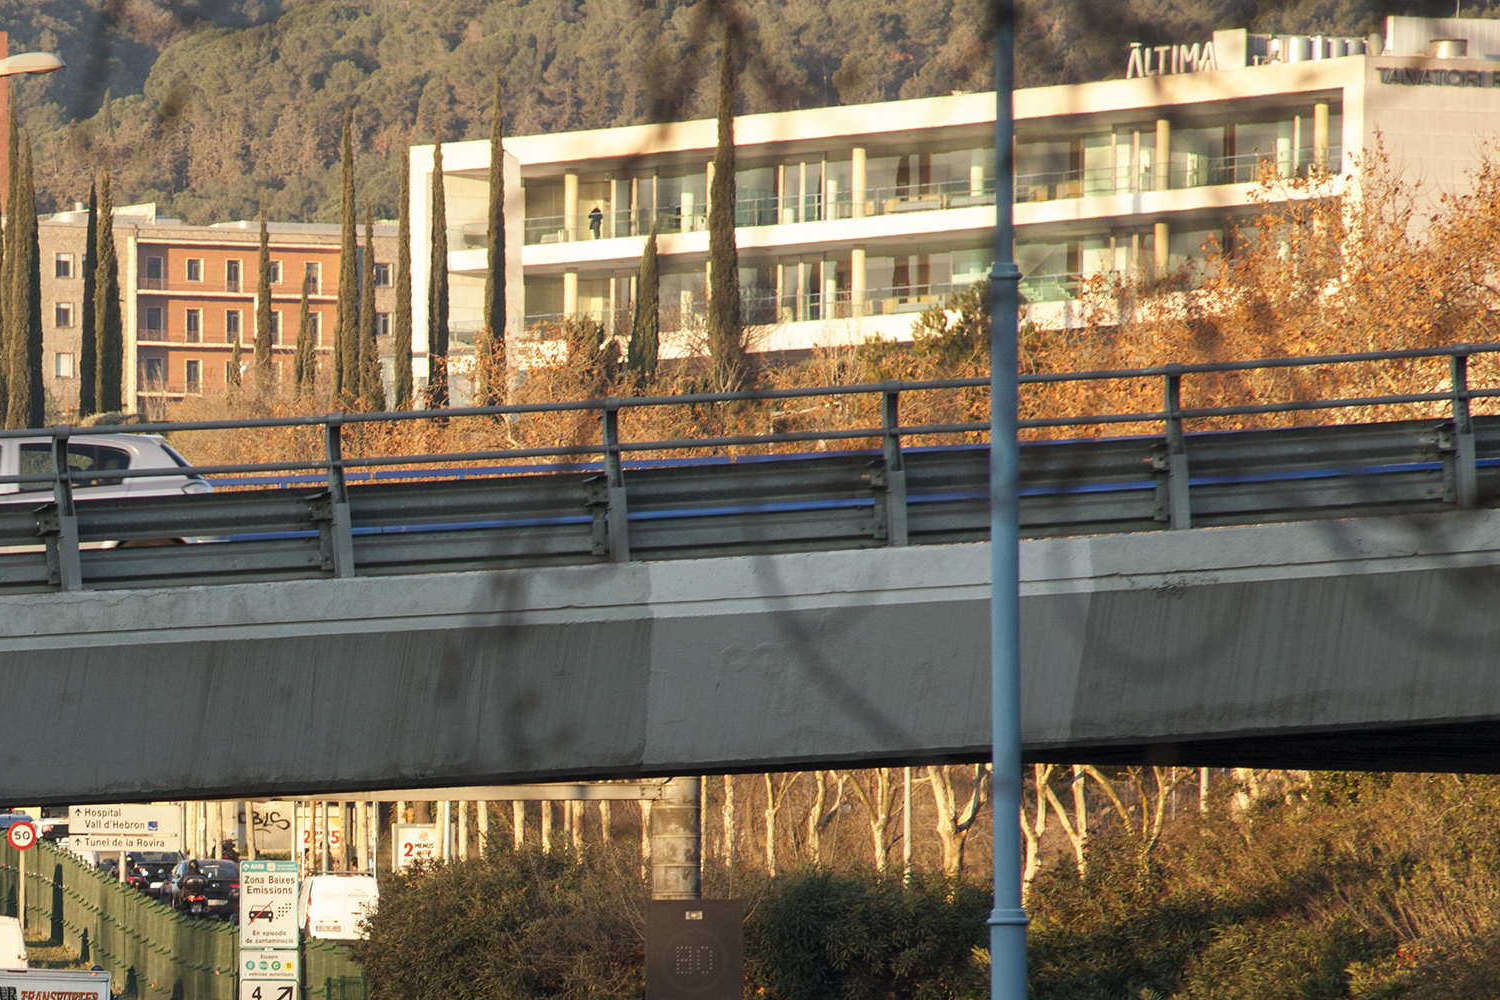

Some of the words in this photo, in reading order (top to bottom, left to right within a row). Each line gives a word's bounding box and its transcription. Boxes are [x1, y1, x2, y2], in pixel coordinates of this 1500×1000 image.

[1375, 67, 1483, 88] TANATORI
[84, 808, 122, 818] Hospital
[85, 820, 101, 829] Vall
[104, 820, 145, 830] d'Hebron
[14, 831, 31, 840] 50
[85, 837, 109, 847] Túnel
[112, 838, 123, 847] de
[126, 838, 133, 847] la
[137, 839, 165, 848] Rovira
[404, 842, 414, 857] 2
[244, 875, 264, 884] Zona
[268, 875, 295, 884] Baixes
[246, 886, 293, 894] Emissions
